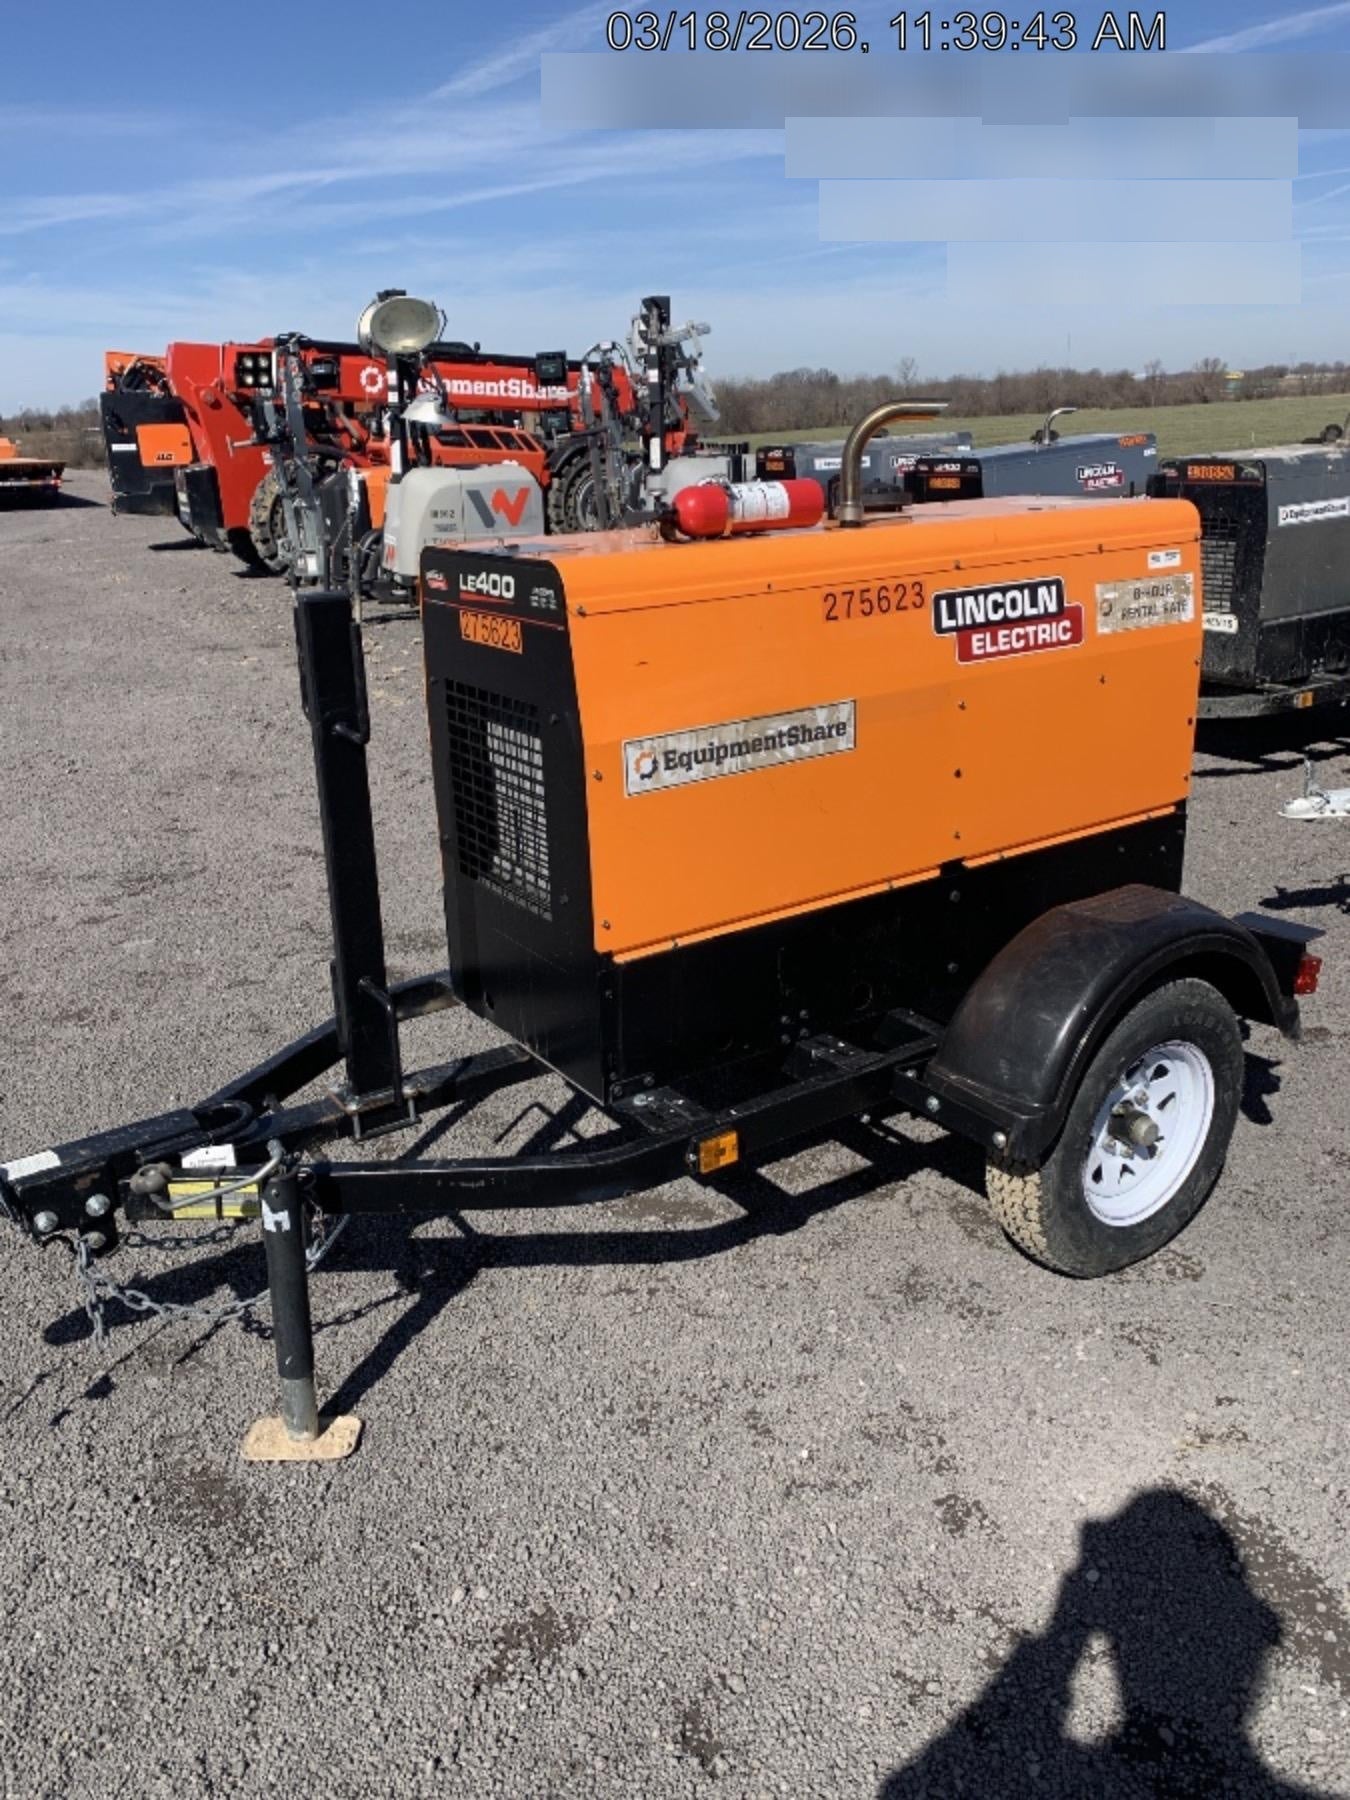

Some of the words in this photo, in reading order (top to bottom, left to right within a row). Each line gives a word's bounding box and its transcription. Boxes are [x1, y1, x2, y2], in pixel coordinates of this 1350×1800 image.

[459, 572, 515, 600] LE400
[824, 582, 925, 622] 275623
[940, 584, 1058, 630] LINCOLN
[461, 611, 521, 650] 275623
[971, 619, 1073, 656] ELECTRIC
[663, 721, 847, 772] EquipmentShare
